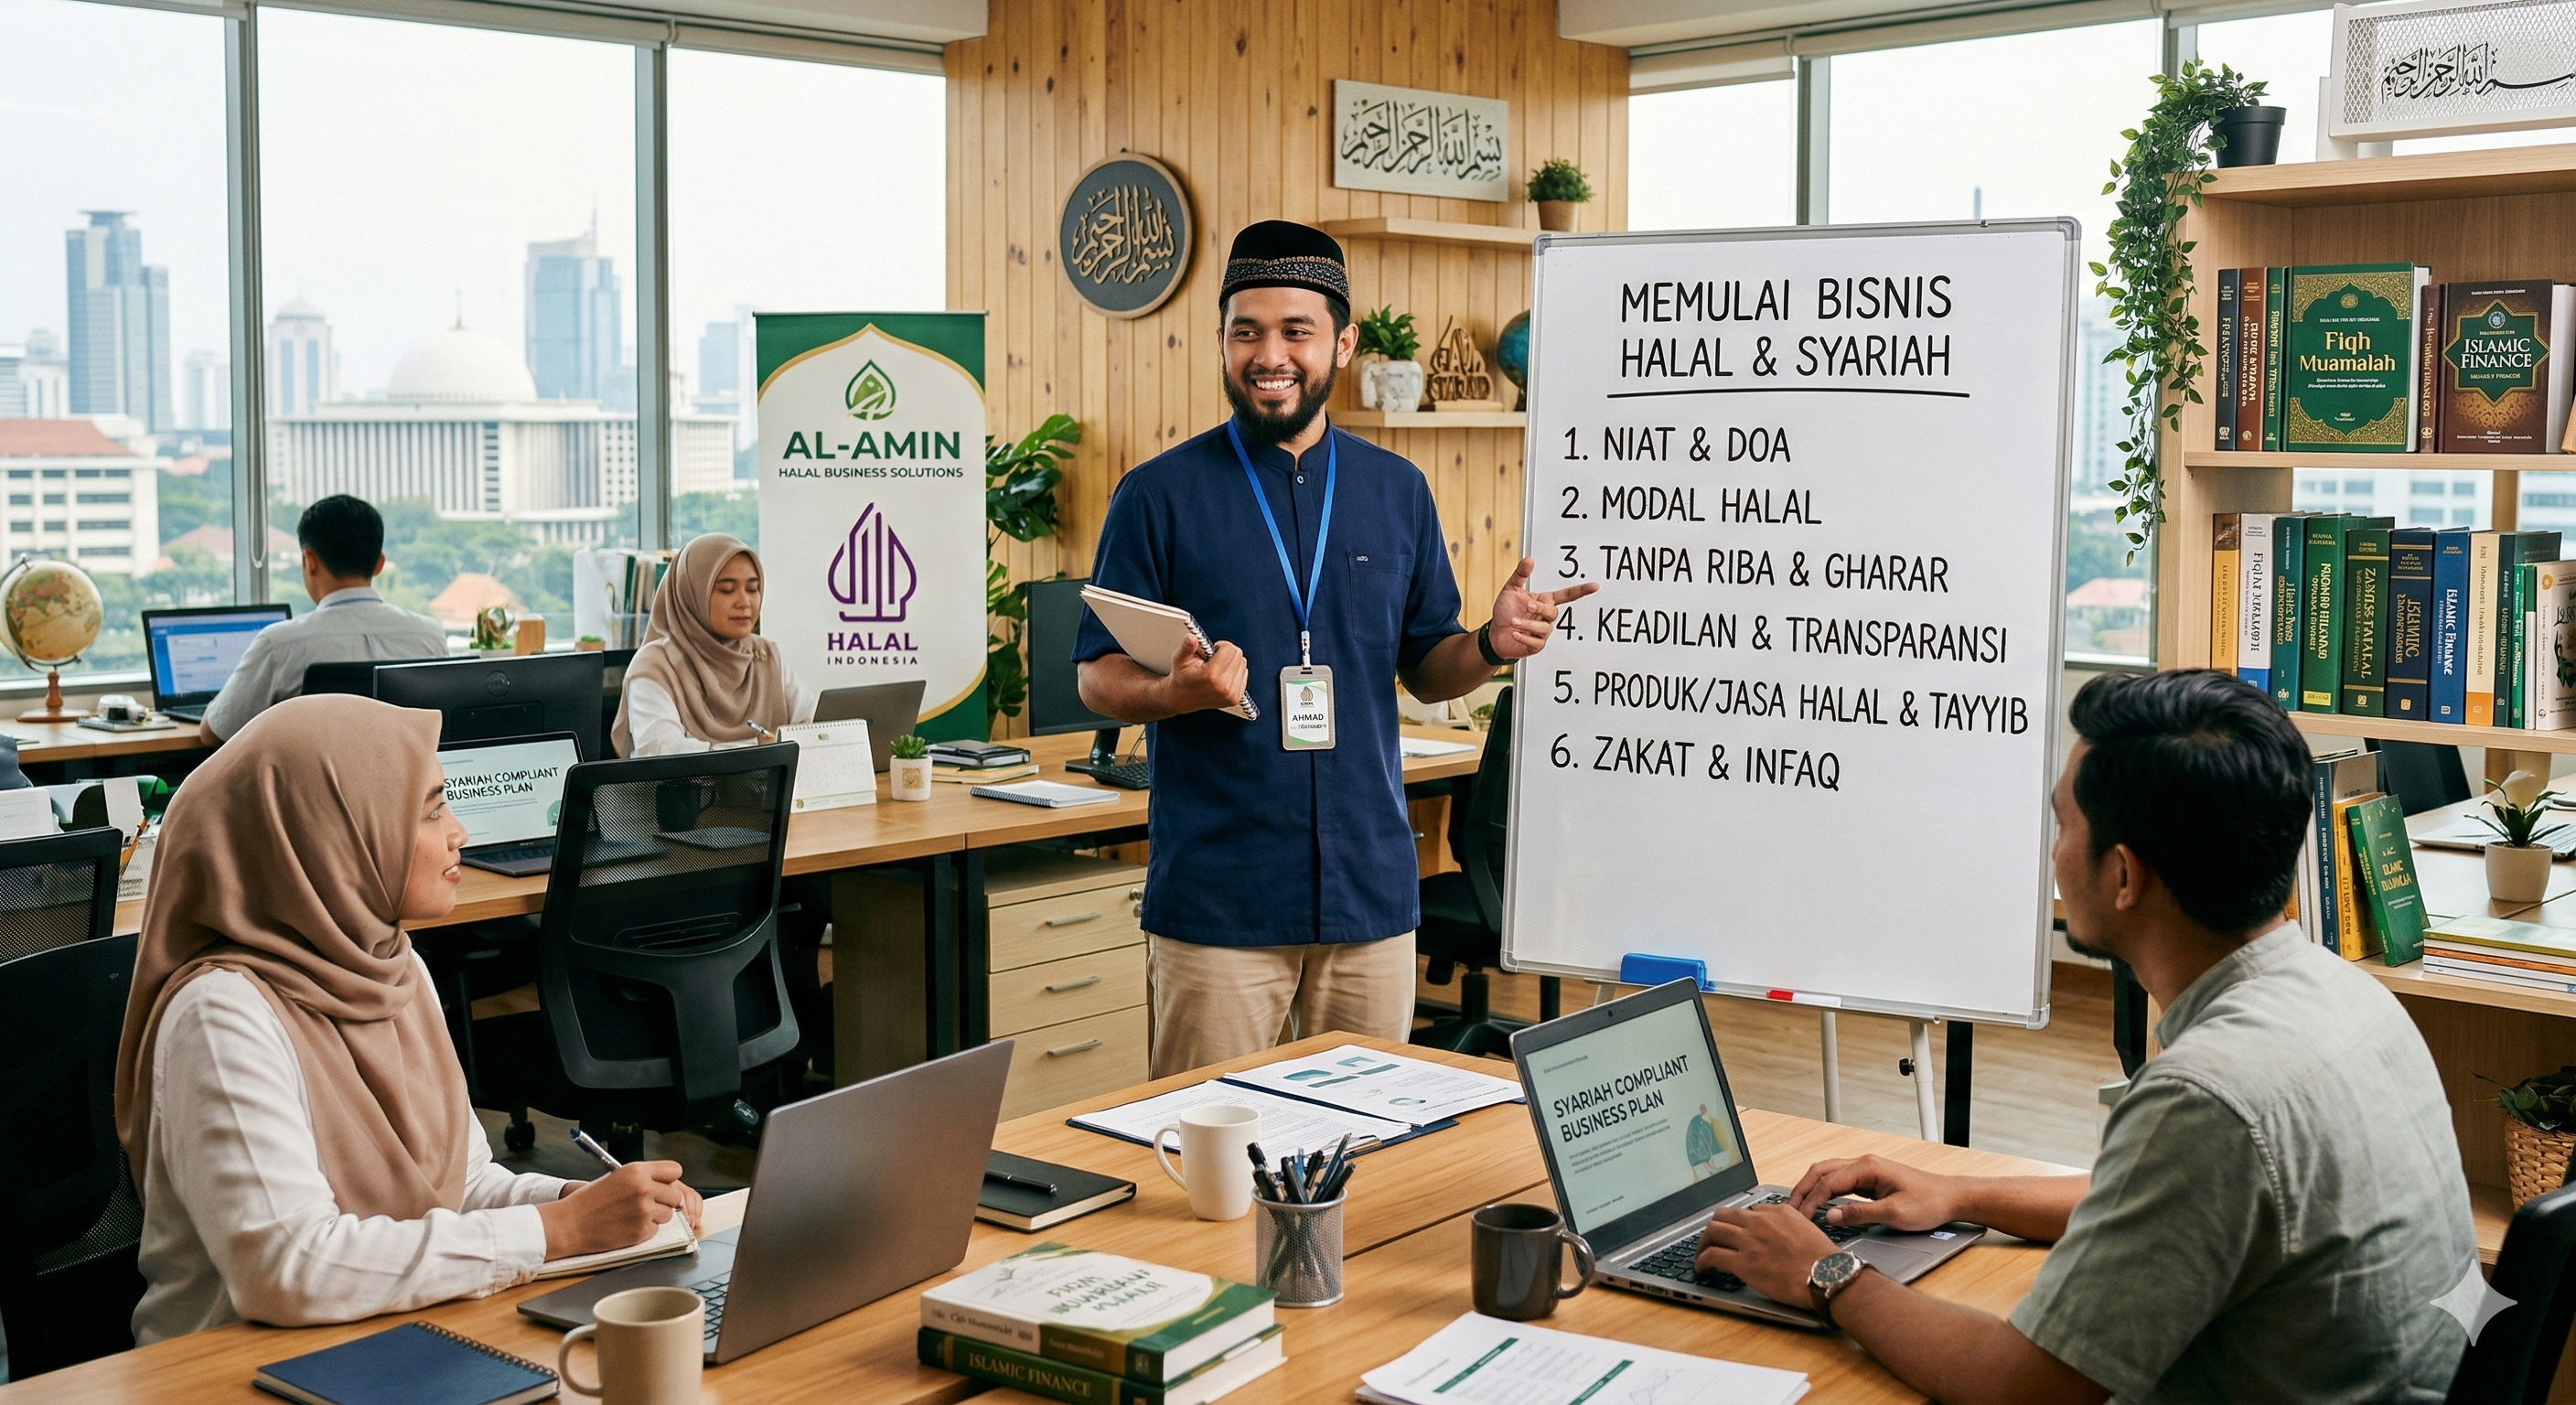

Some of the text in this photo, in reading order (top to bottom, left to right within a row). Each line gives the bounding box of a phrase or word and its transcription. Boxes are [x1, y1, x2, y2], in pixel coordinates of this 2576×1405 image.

[1621, 274, 1952, 323] MEMULAI BISNIS
[1621, 334, 1950, 378] HALAL & SYARIAH
[2324, 331, 2371, 355] Fiqh
[2463, 338, 2530, 353] ISLAMIC
[2300, 354, 2396, 372] Muamalah
[2460, 353, 2532, 369] FINANCE
[782, 431, 961, 460] AL-AMIN
[1563, 426, 1791, 463] 1. NIAT & DOA
[778, 467, 964, 478] HALAL BUSINESS SOLUTIONS
[1561, 485, 1822, 525] 2. MODAL HALAL
[1558, 545, 1948, 594] 3. TANPA RIBA & GHARAR
[827, 632, 918, 651] HALAL
[1557, 606, 2007, 664] 4. KEADILAN & TRANSPARANSI
[827, 656, 918, 665] INDONESIA
[1292, 713, 1325, 722] AHMAD
[1553, 670, 2029, 735] 5. PRODUK/JASA HALAL & TAYYIB
[494, 767, 558, 783] COMPLIANT
[1551, 733, 1841, 792] 6. ZAKAT & INFAQ
[446, 782, 533, 800] BUSINESS PLAN
[1553, 1082, 1614, 1119] SYARIAH
[1615, 1055, 1689, 1096] COMPLIANT
[1561, 1089, 1665, 1142] BUSINESS PLAN
[969, 1353, 1091, 1398] ISLAMIC FINANCE
